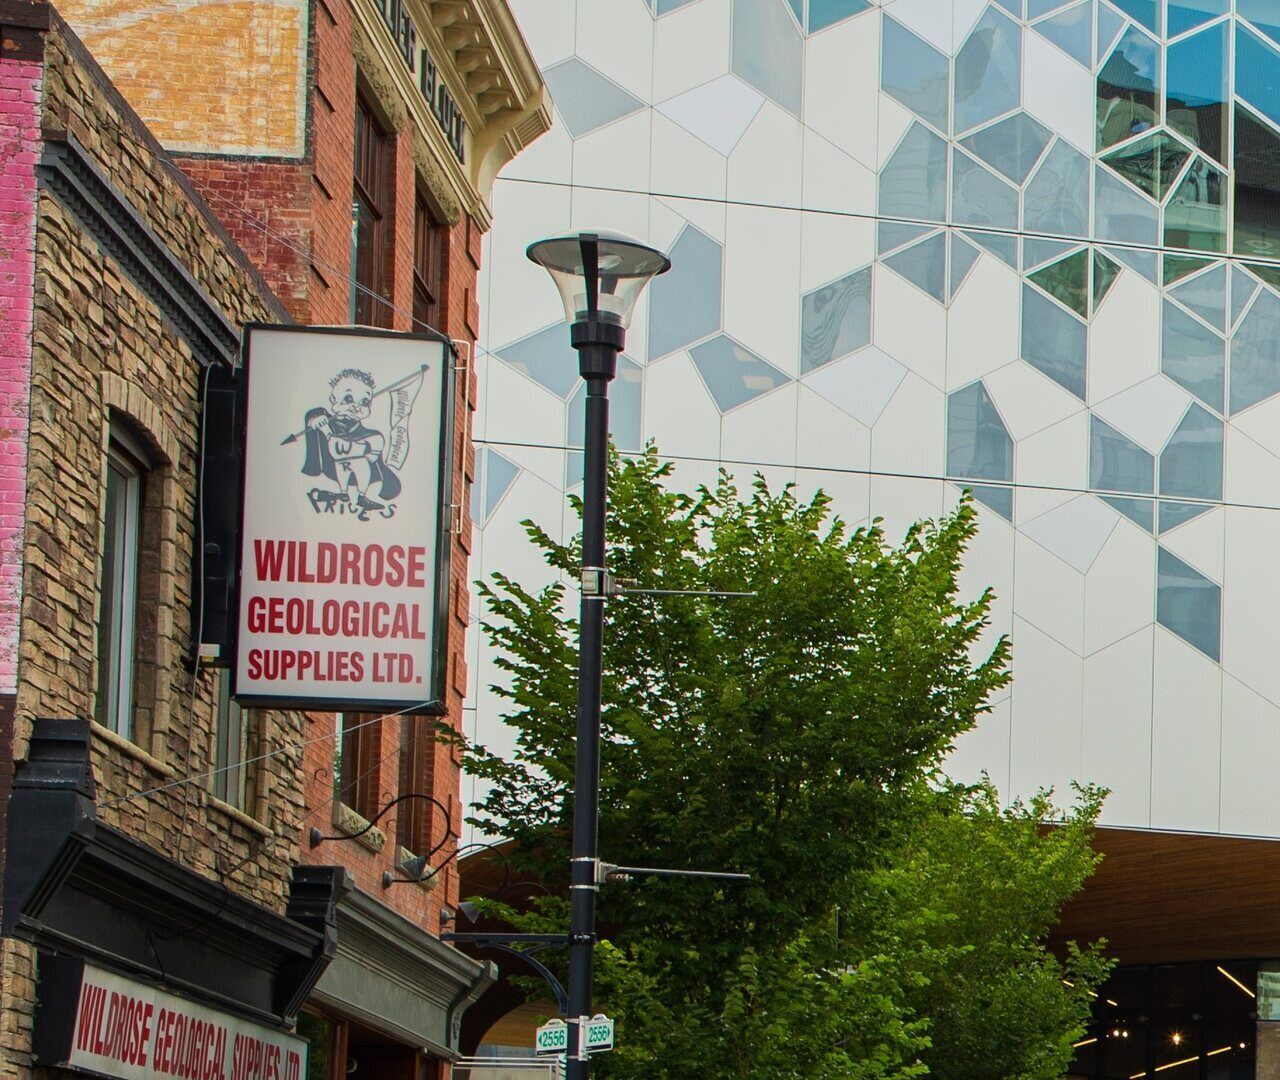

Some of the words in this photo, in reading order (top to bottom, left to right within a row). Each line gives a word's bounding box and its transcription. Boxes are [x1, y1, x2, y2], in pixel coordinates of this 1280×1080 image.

[421, 49, 466, 165] BLOCK
[254, 539, 426, 588] WILDROSE
[247, 596, 426, 640] GEOLOGICAL
[247, 649, 364, 683] SUPPLIES
[372, 652, 422, 684] LTD.
[76, 982, 153, 1067] WILDROSE
[542, 1029, 565, 1047] 2556
[588, 1025, 607, 1043] 2556
